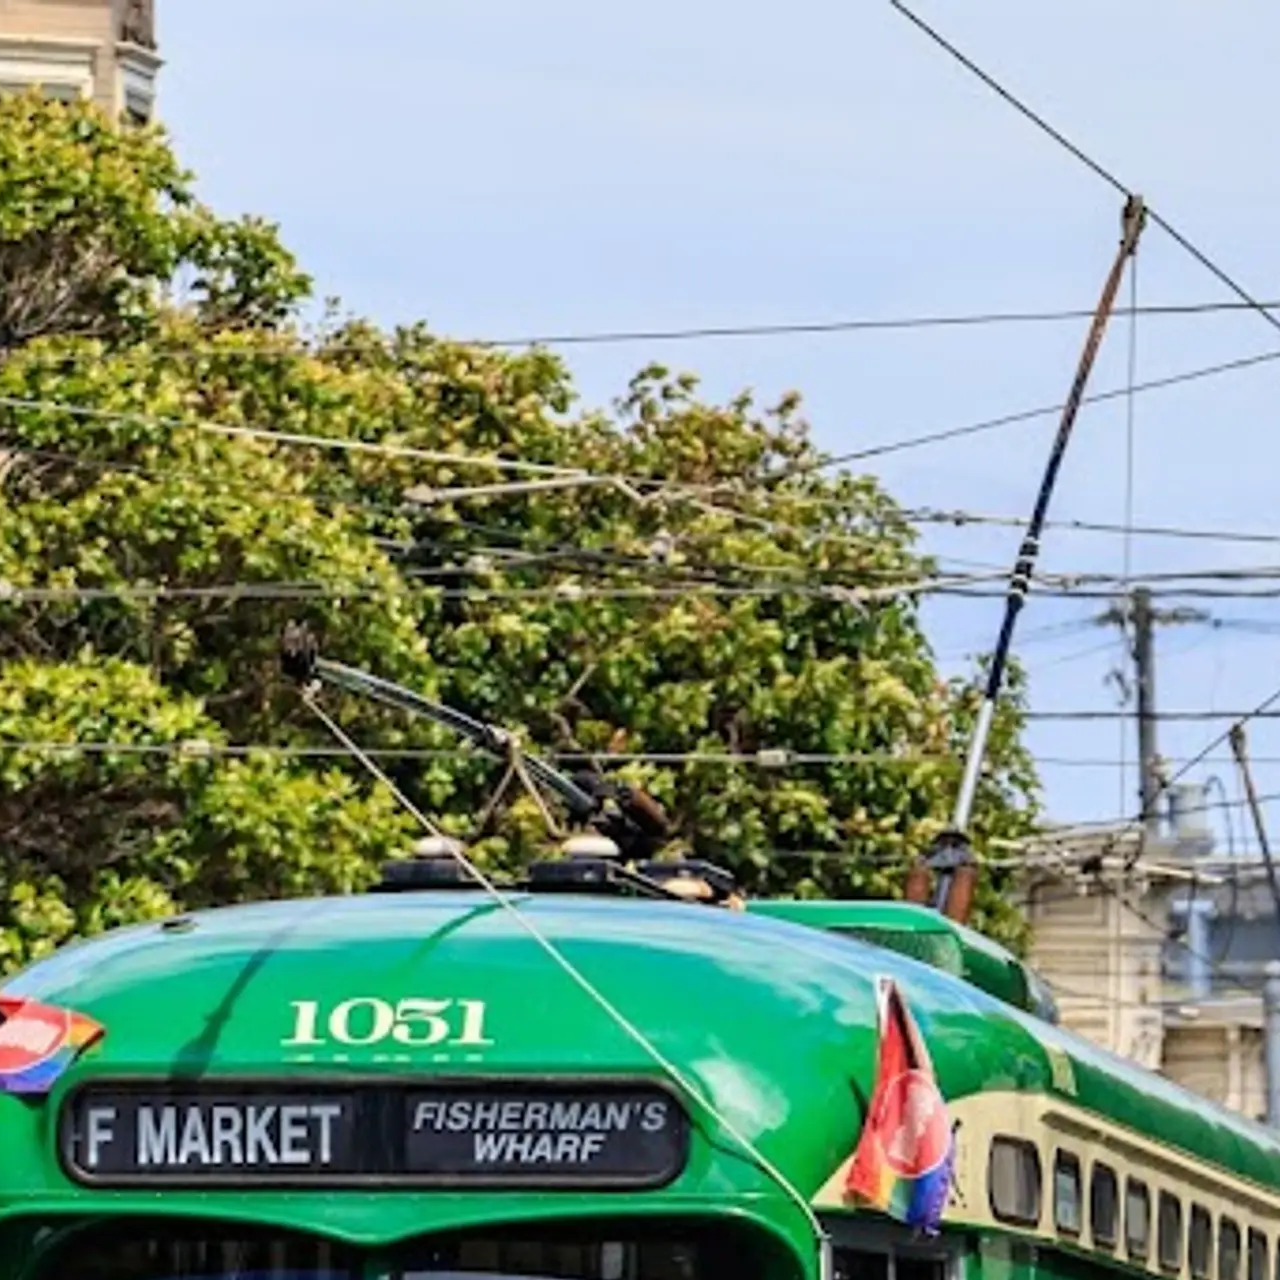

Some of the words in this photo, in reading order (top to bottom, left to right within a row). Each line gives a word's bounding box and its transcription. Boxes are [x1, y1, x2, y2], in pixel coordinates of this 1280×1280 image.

[280, 998, 495, 1046] 1051
[88, 1109, 116, 1165] F
[137, 1106, 341, 1164] MARKET
[414, 1102, 668, 1131] FISHERMAN'S
[474, 1133, 606, 1162] WHARF
